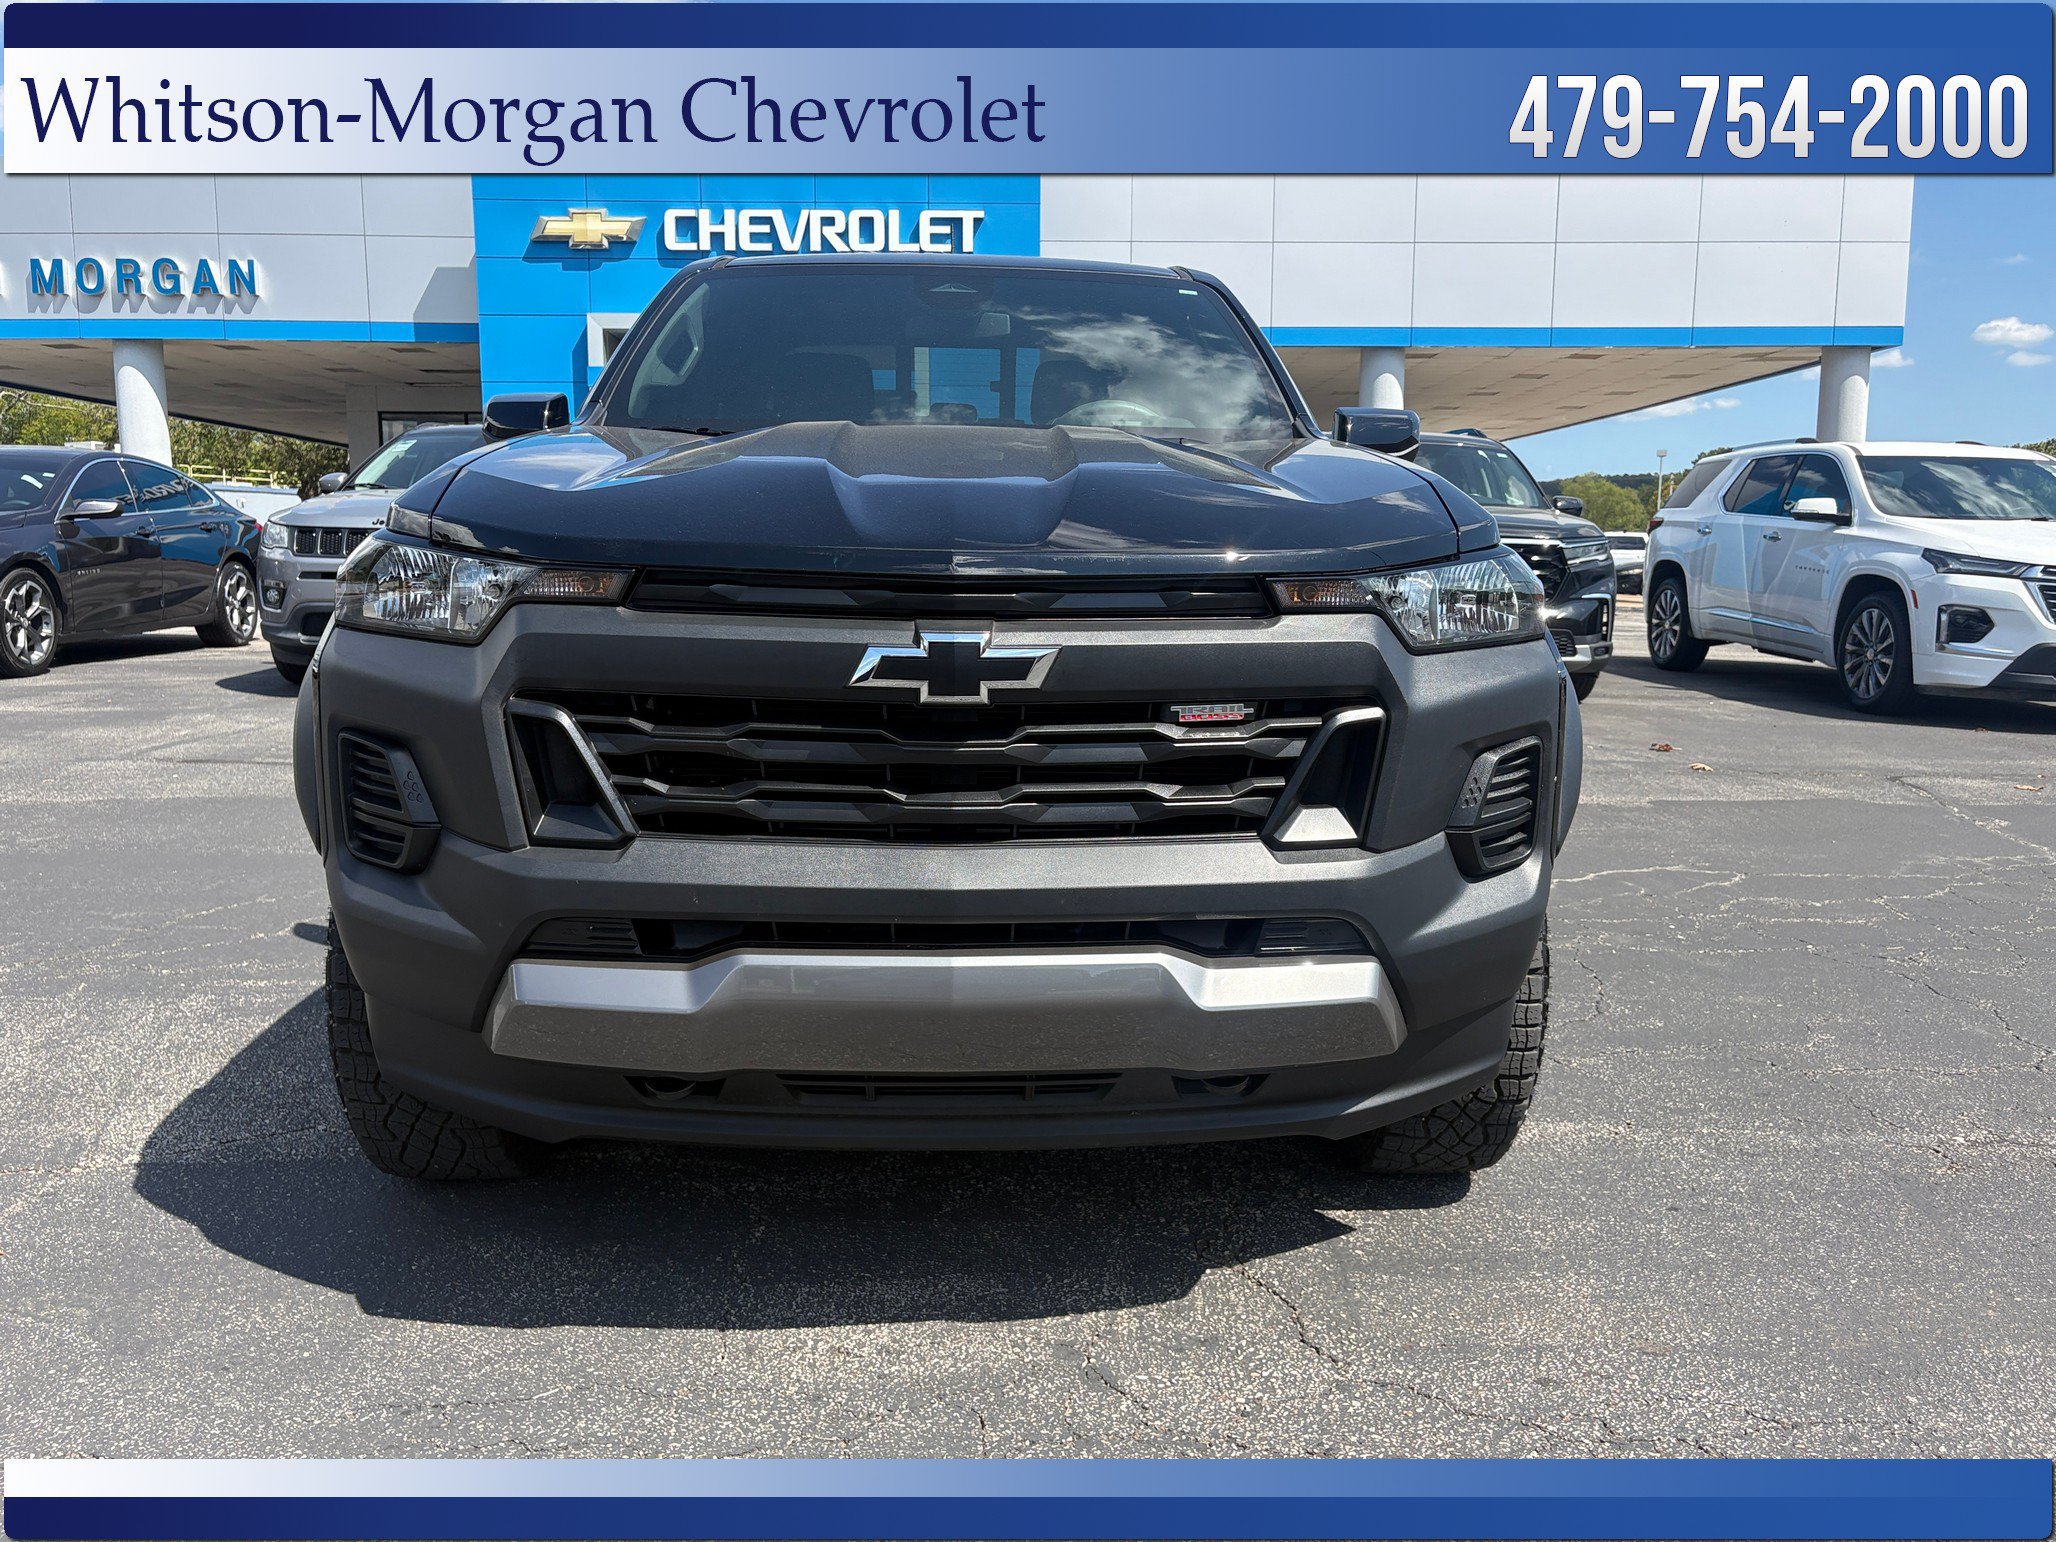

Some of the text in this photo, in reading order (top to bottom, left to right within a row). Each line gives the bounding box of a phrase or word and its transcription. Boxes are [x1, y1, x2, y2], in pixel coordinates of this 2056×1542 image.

[663, 208, 985, 253] CHEVROLET
[29, 257, 257, 297] MORGAN
[371, 518, 386, 526] Je
